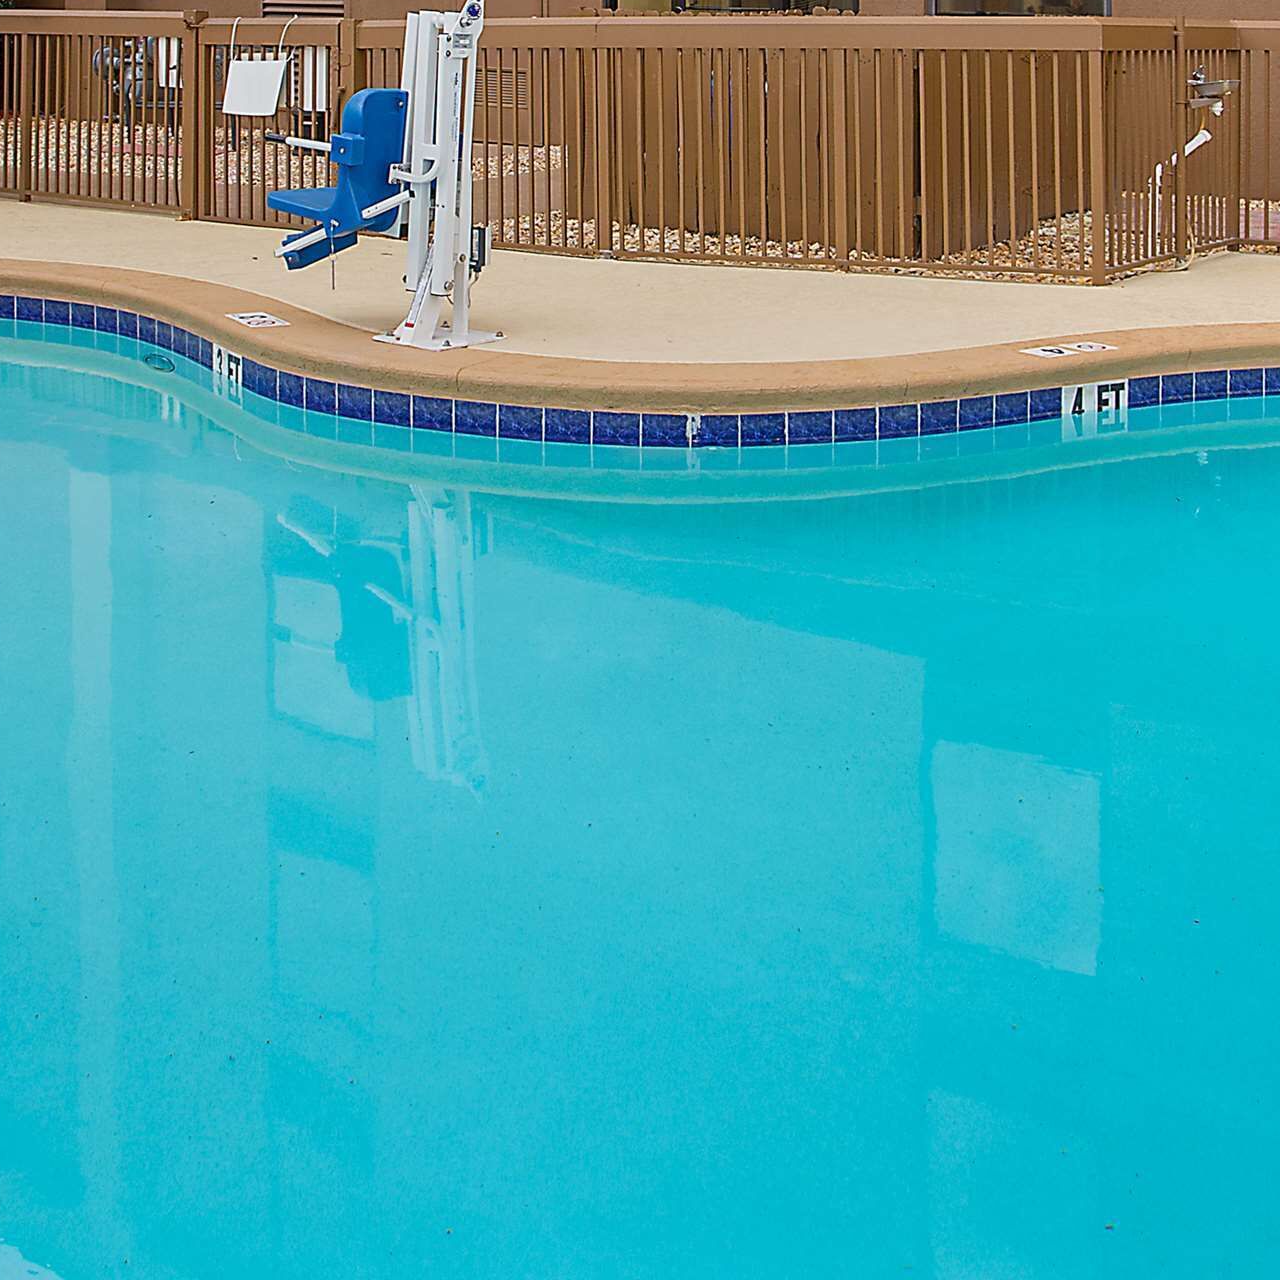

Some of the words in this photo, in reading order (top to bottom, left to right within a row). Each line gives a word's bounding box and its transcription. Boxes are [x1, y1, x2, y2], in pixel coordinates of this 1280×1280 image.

[227, 353, 240, 385] FT
[1071, 386, 1086, 415] 4
[1097, 382, 1125, 413] FT
